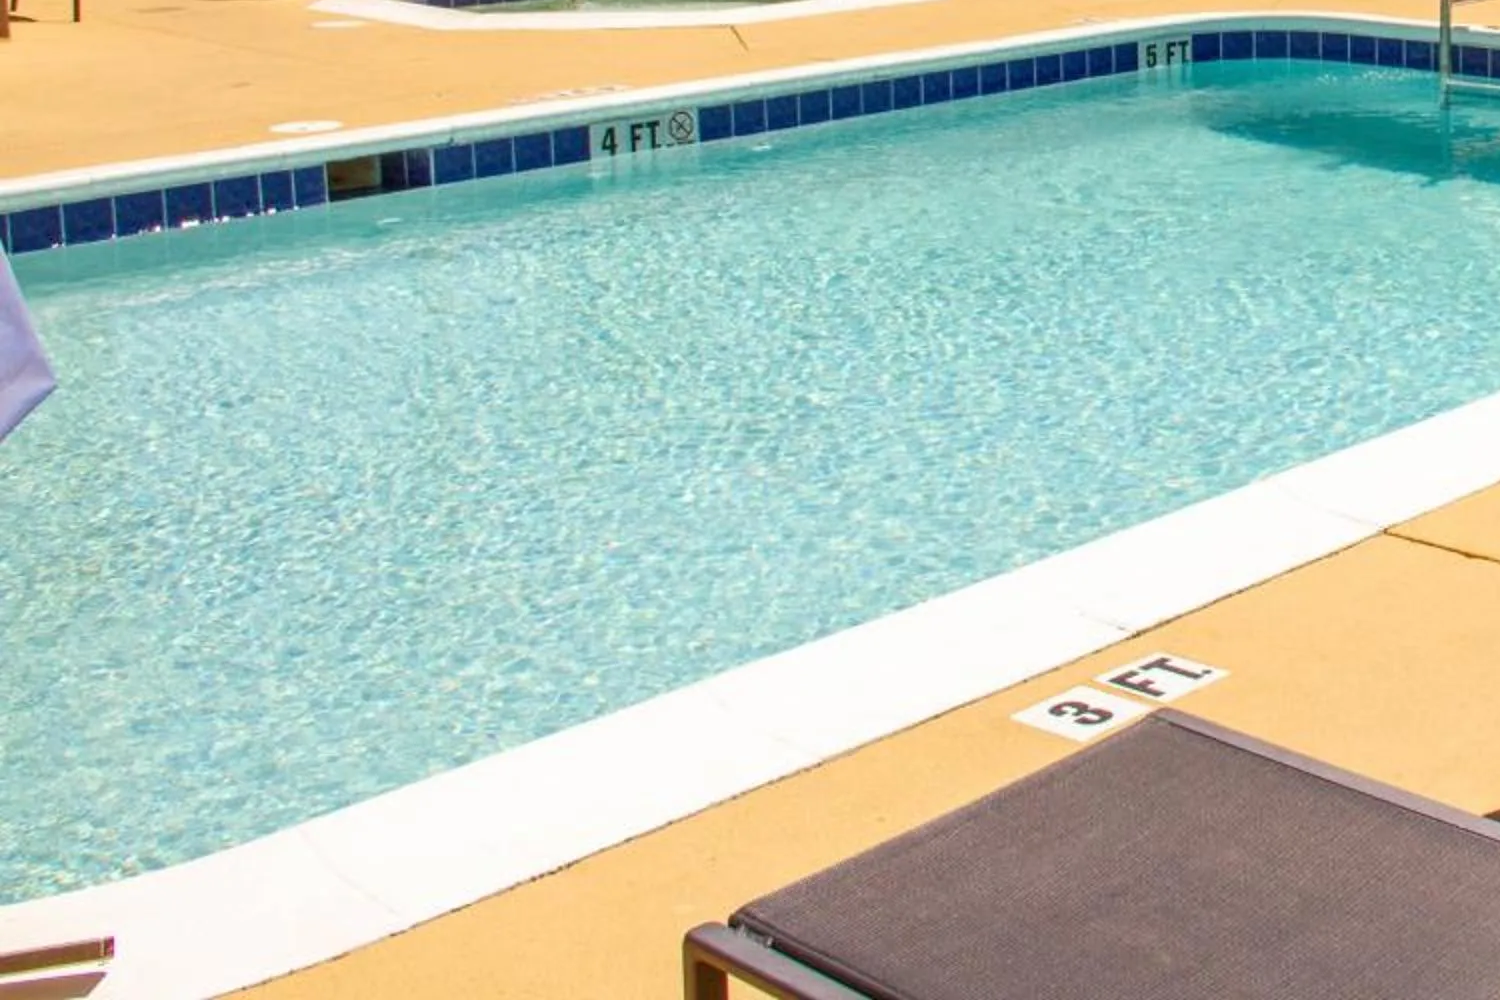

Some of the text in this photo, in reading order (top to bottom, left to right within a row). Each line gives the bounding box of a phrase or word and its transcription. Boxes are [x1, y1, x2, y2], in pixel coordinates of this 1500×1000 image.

[1145, 42, 1157, 69] 5
[601, 126, 619, 157] 4
[1048, 656, 1213, 725] 3 FT.
